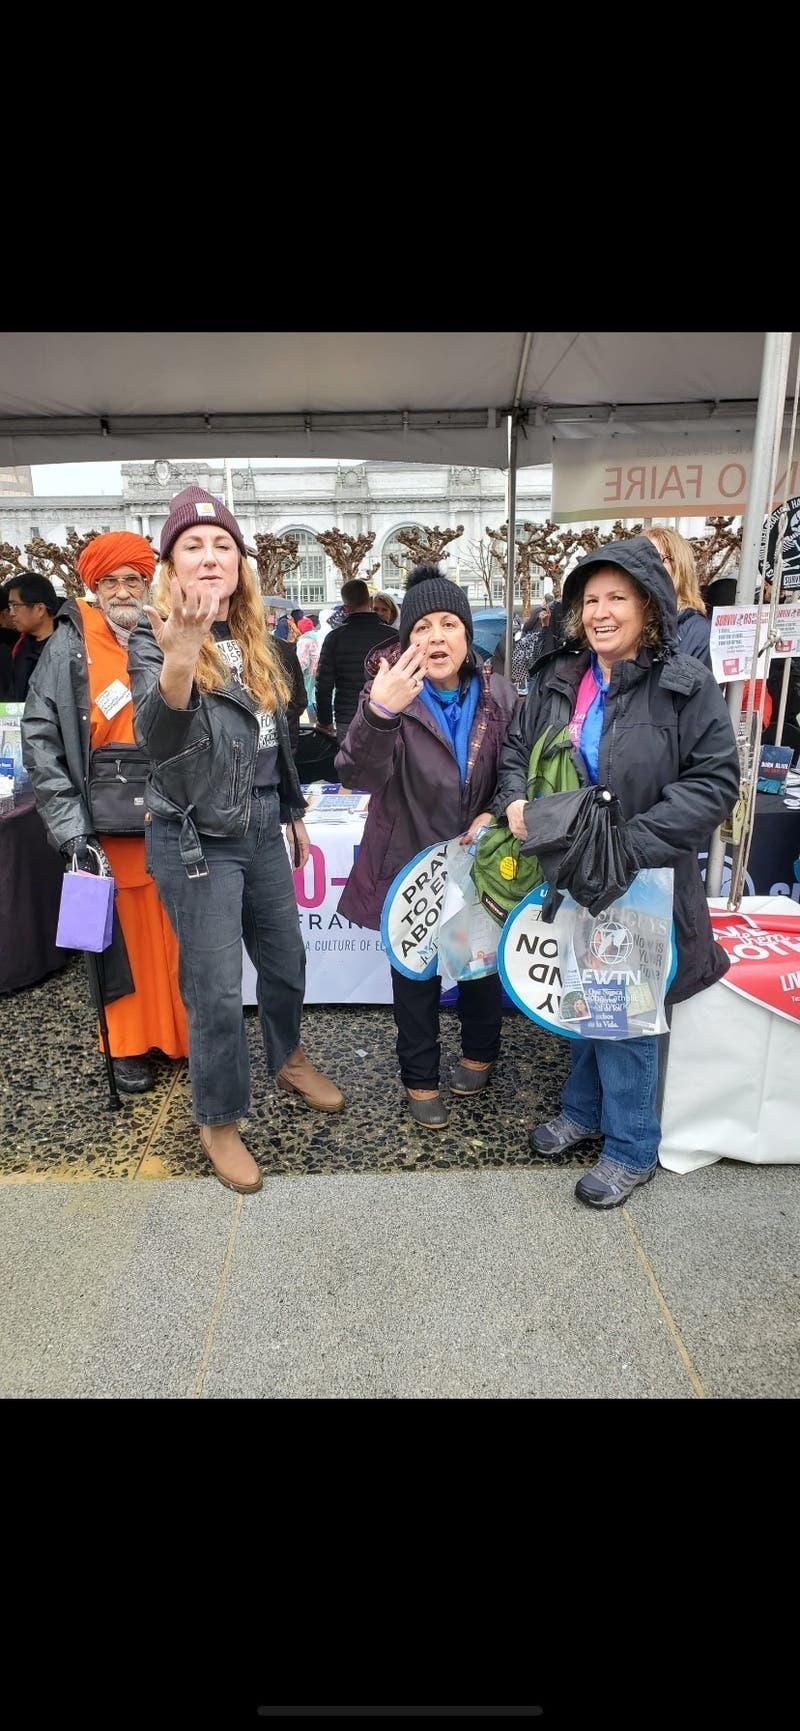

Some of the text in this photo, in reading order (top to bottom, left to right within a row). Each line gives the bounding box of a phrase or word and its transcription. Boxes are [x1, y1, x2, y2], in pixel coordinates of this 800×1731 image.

[402, 845, 448, 904] PRAY
[401, 897, 428, 926] TO
[315, 940, 357, 951] CULTURE
[359, 940, 372, 951] OF
[581, 968, 641, 986] EWTN
